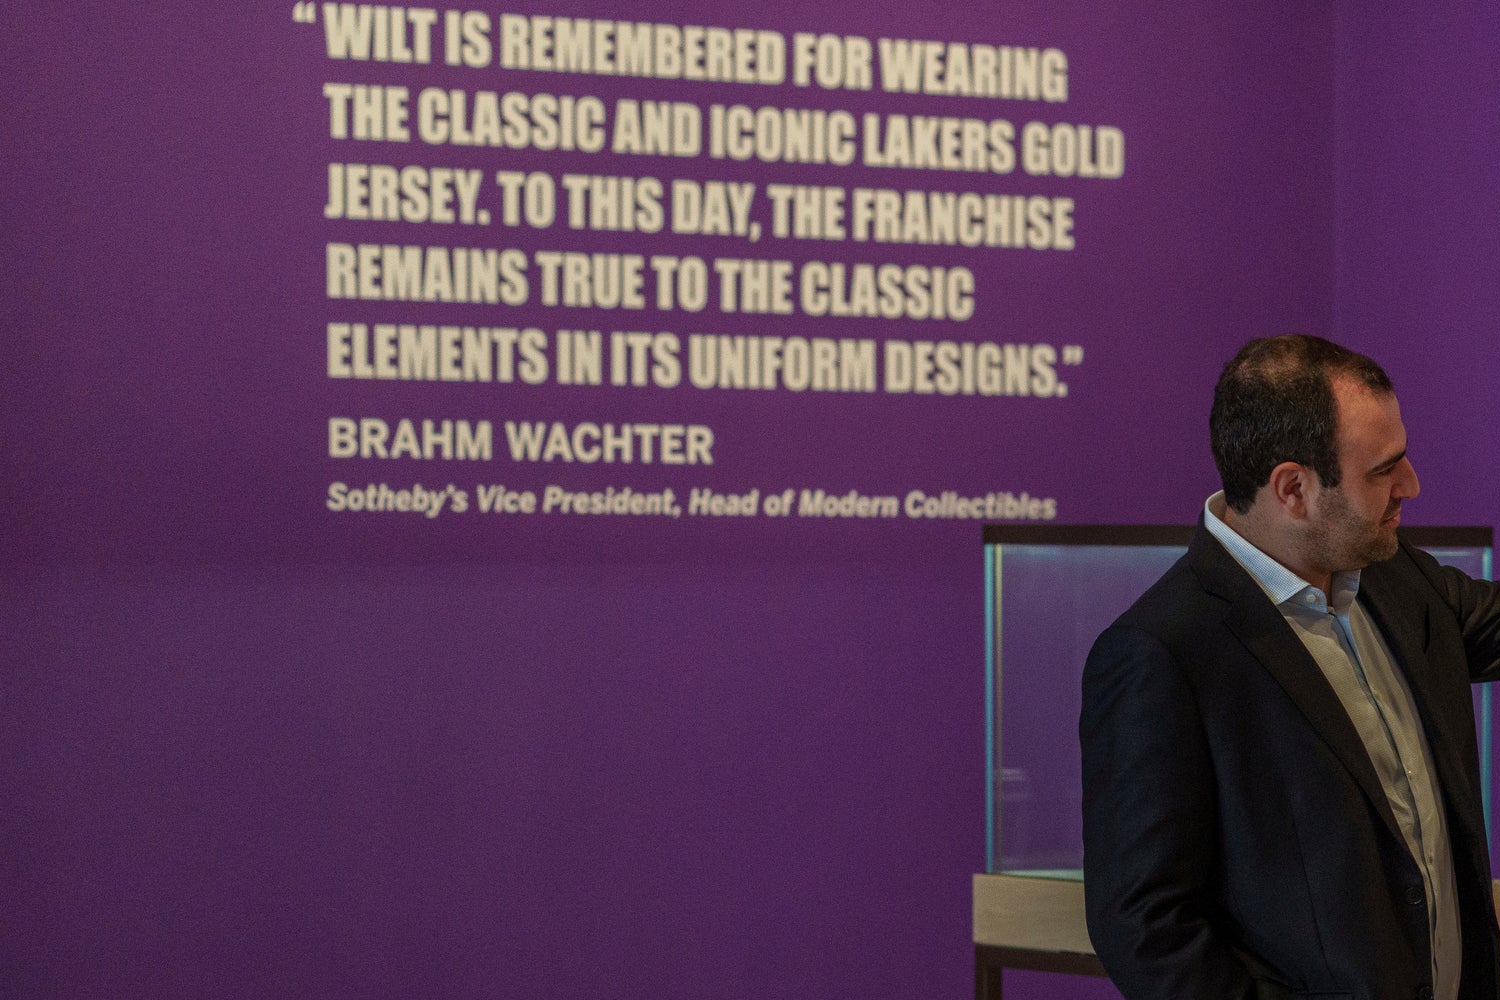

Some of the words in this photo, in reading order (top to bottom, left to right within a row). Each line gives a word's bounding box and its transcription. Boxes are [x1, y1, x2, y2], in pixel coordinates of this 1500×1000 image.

[444, 9, 493, 69] IS
[500, 13, 786, 85] REMEMBERED
[793, 32, 873, 91] FOR
[878, 37, 1068, 102] WEARING
[322, 82, 411, 143] THE
[417, 87, 606, 153] CLASSIC
[612, 99, 702, 157] AND
[709, 104, 856, 166] ICONIC
[863, 112, 1016, 174] LAKERS
[1022, 121, 1125, 179] GOLD
[324, 162, 491, 225] JERSEY.
[496, 170, 556, 228] TO
[561, 174, 664, 233] THIS
[672, 179, 762, 242] DAY,
[766, 184, 846, 241] THE
[852, 188, 1075, 250] FRANCHISE
[326, 242, 529, 306] REMAINS
[535, 251, 645, 309] TRUE
[650, 255, 708, 312] TO
[714, 258, 794, 314] THE
[800, 261, 975, 321] CLASSIC
[327, 322, 549, 384] ELEMENTS
[556, 330, 602, 385] IN
[611, 331, 681, 388] ITS
[689, 334, 876, 392] UNIFORM
[884, 340, 1084, 397] DESIGNS.”
[328, 417, 492, 460] BRAHM
[505, 421, 714, 465] WACHTER
[327, 482, 468, 518] Sotheby’s
[477, 485, 537, 513] Vice
[542, 485, 681, 516] President,
[688, 488, 760, 516] Head
[763, 489, 794, 516] of
[798, 489, 899, 517] Modern
[904, 490, 1055, 518] Collectibles
